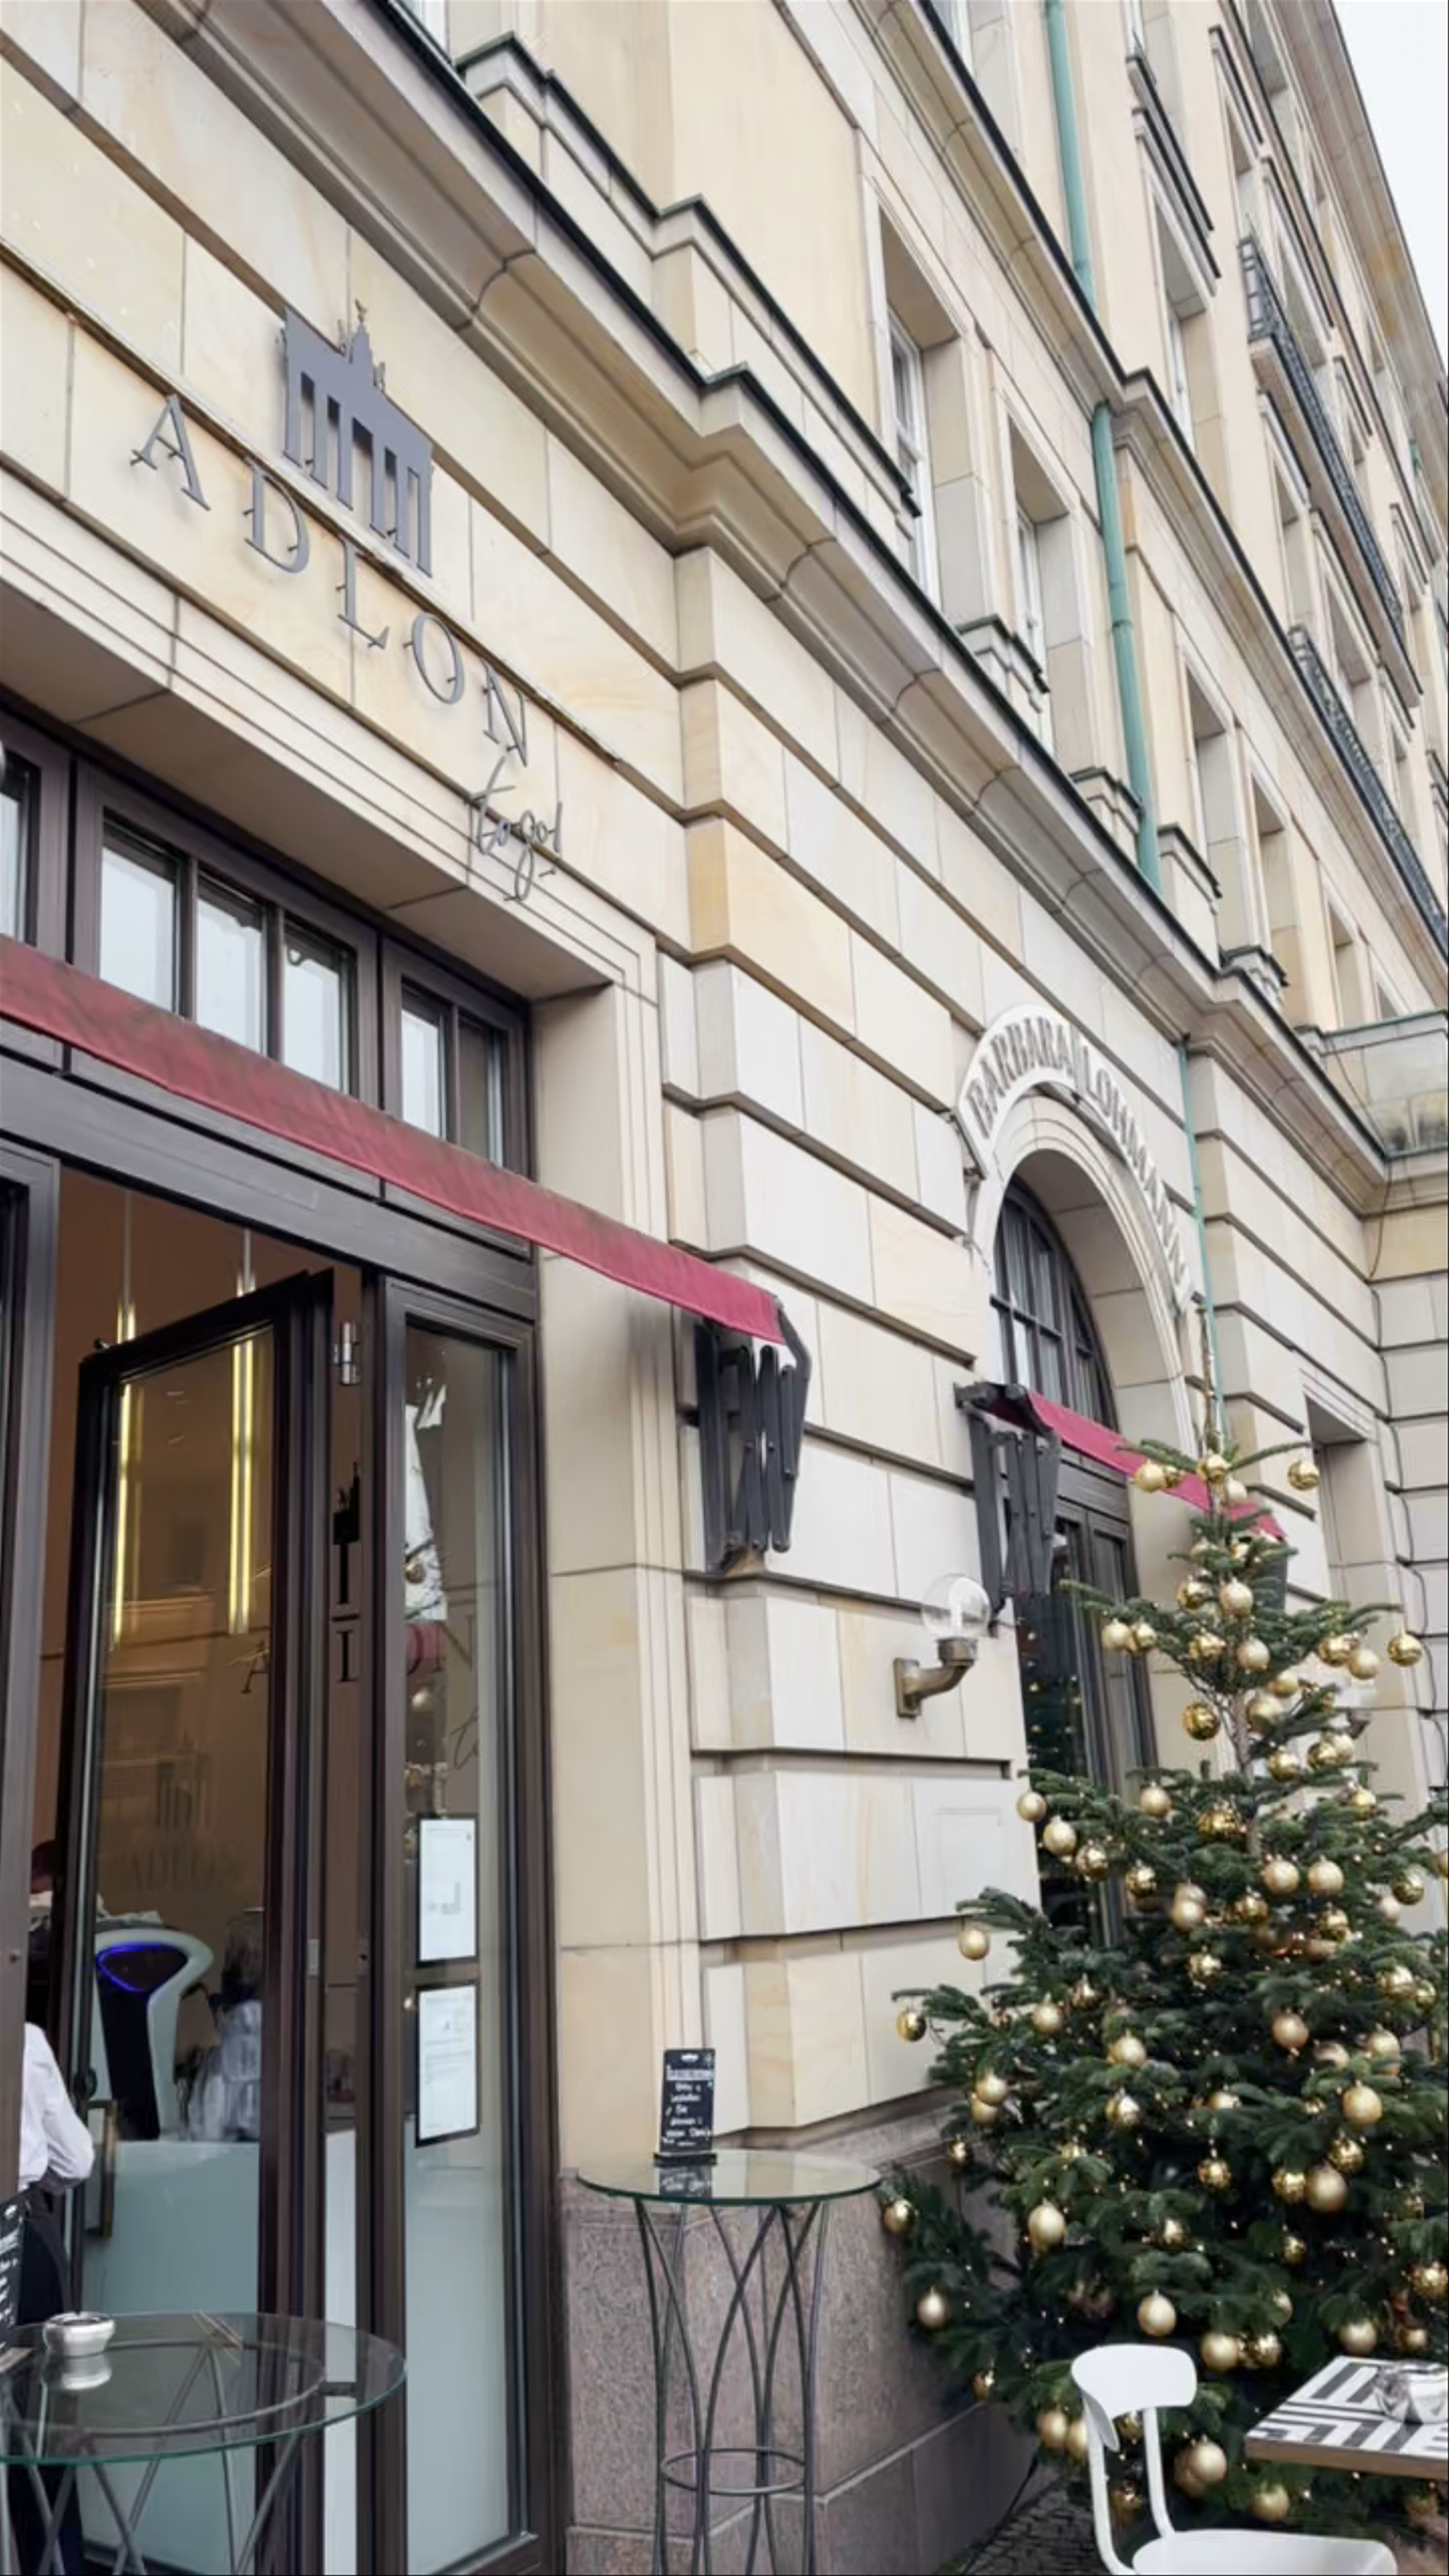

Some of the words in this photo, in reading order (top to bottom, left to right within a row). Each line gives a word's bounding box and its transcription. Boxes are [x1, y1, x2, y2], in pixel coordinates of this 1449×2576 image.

[132, 395, 527, 766] ADLON
[966, 1015, 1075, 1139] BARBARA
[1084, 1045, 1186, 1285] LOHMANN
